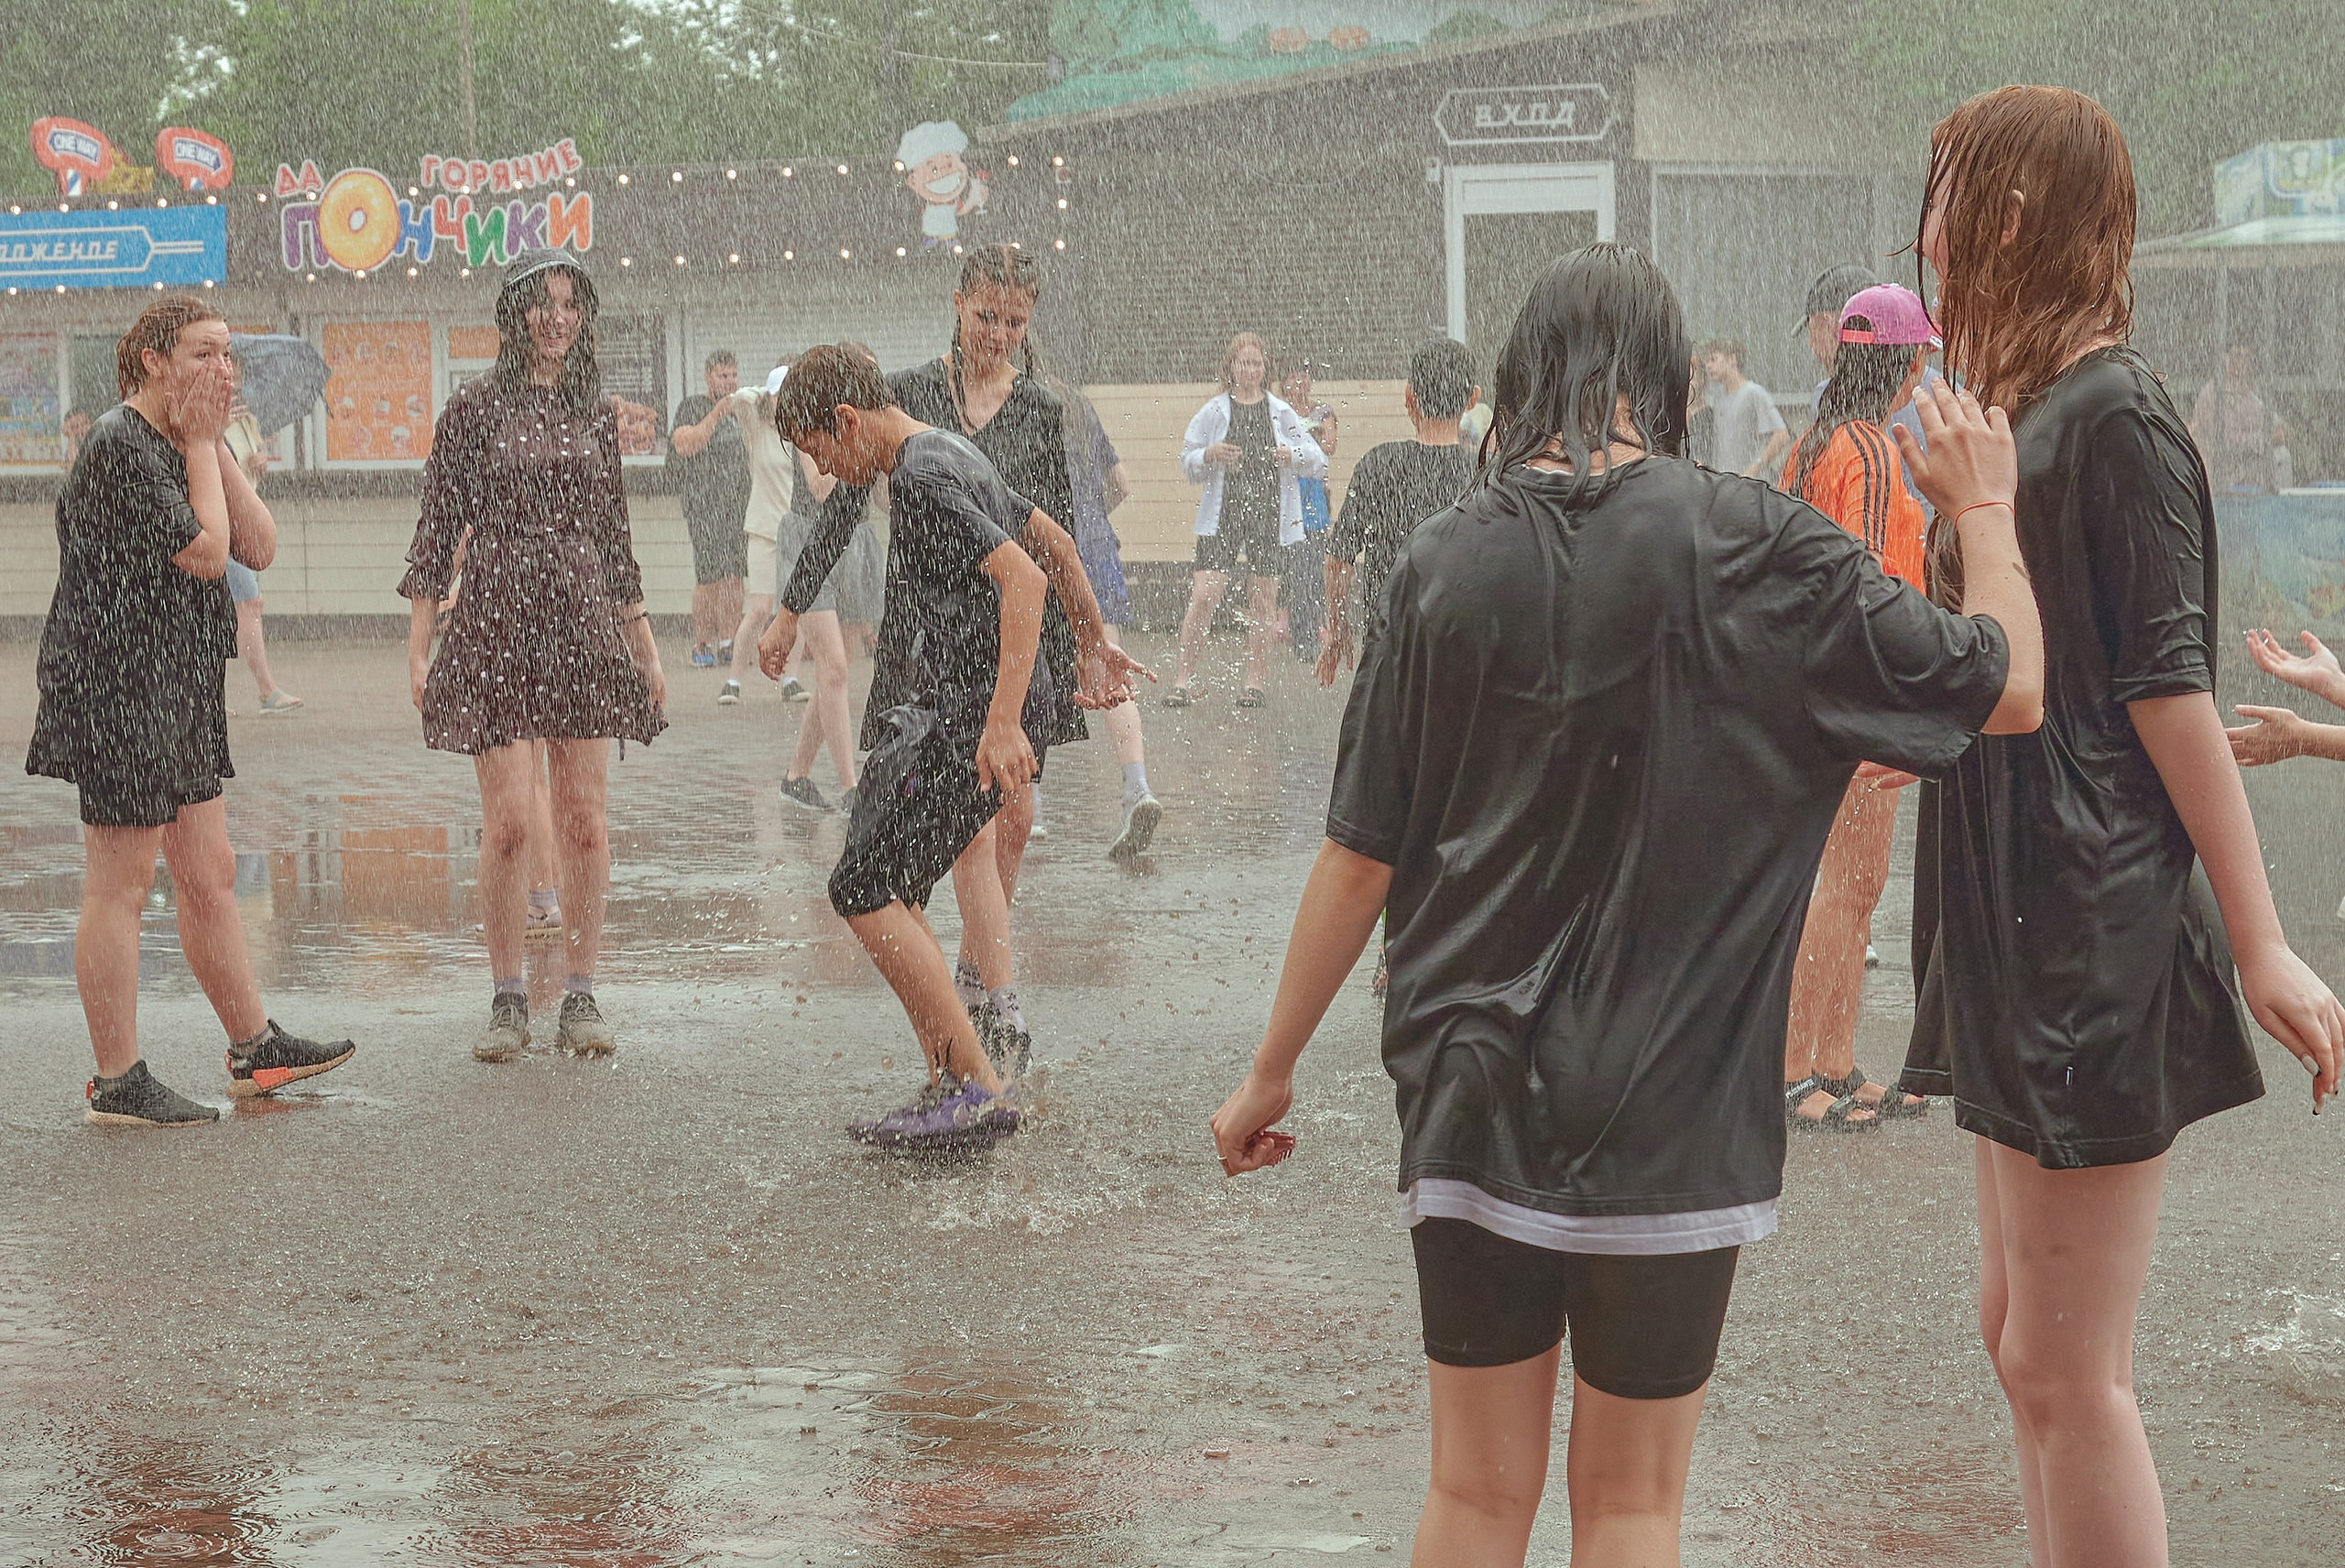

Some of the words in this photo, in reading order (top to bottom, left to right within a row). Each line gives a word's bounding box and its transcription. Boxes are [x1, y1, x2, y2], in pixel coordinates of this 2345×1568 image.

[1475, 101, 1576, 129] ВХОД
[421, 137, 582, 193] ГОРЯЧИЕ
[281, 167, 593, 271] ПОНЧИКИ
